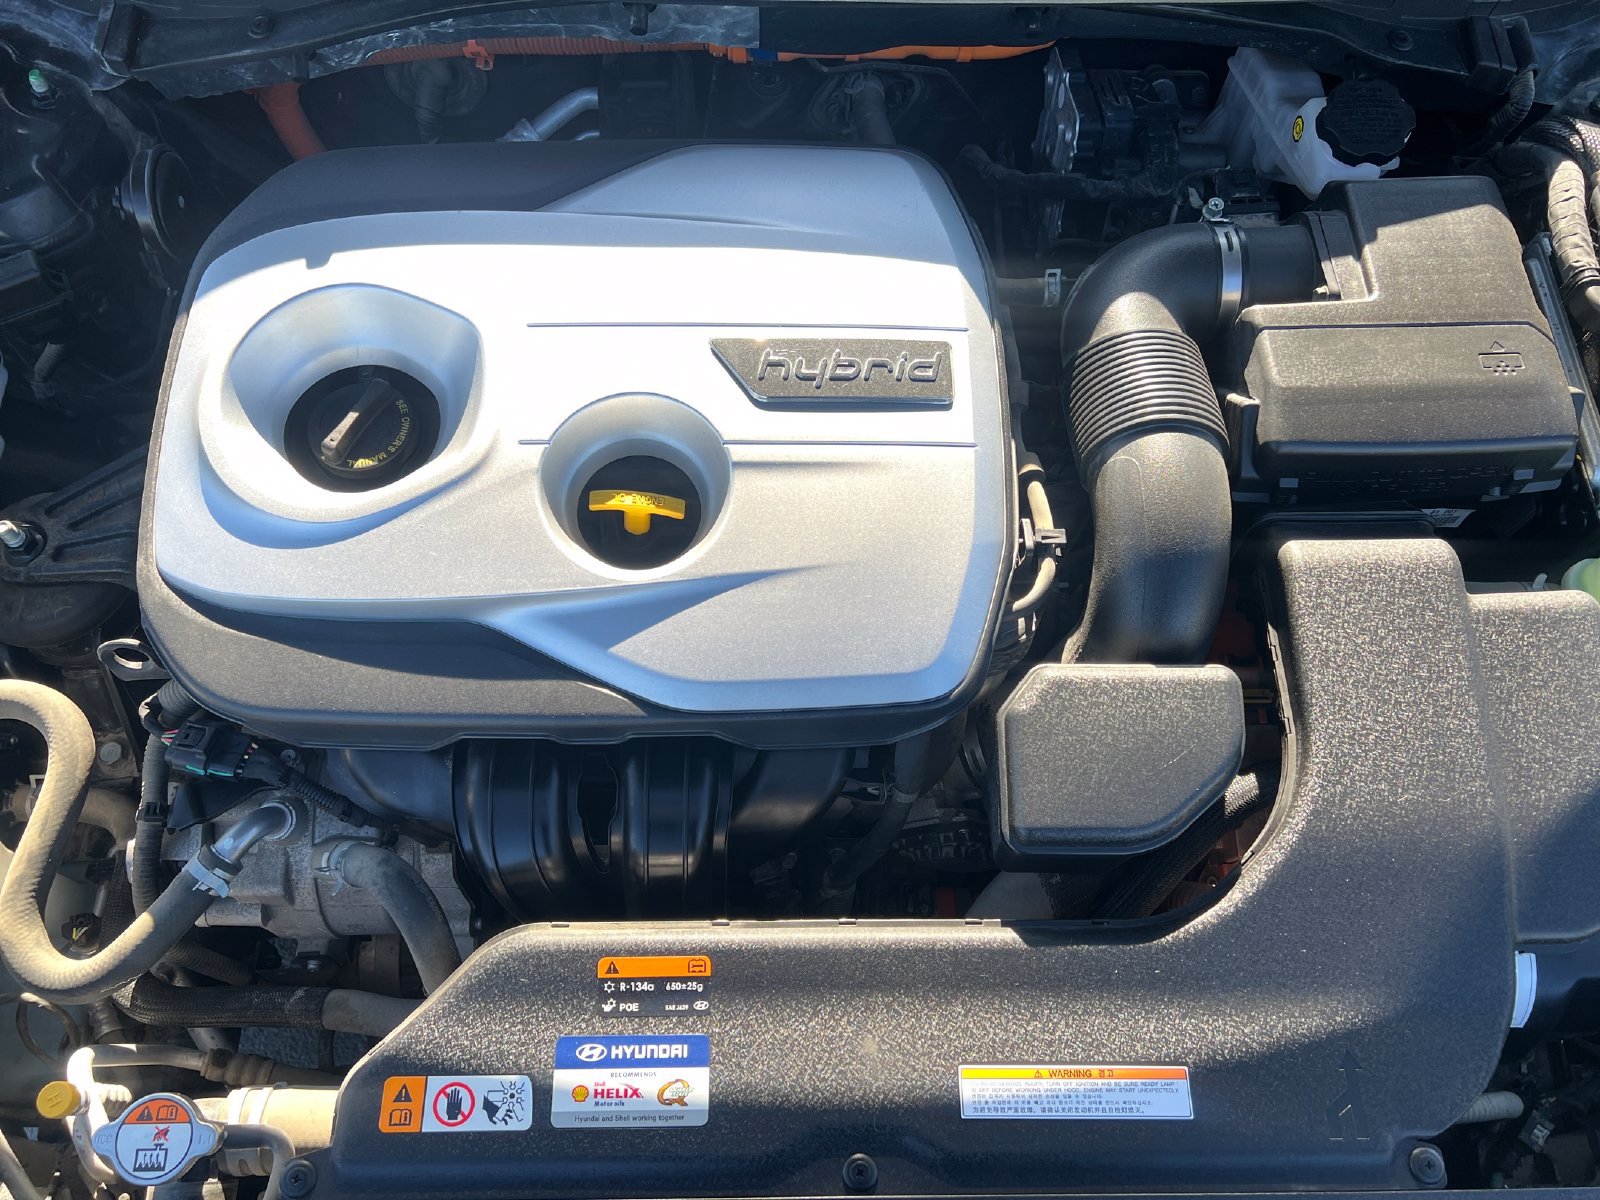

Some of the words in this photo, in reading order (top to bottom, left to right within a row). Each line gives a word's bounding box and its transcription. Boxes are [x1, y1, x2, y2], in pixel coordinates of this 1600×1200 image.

[758, 349, 942, 390] hybrid
[396, 399, 408, 414] SEE
[388, 416, 410, 453] OWNER'S
[346, 451, 388, 468] MANUAL
[620, 982, 654, 992] R-134a
[666, 982, 704, 992] 650±25g
[620, 1003, 639, 1012] POE
[610, 1044, 688, 1059] HYUNDAI
[1048, 1069, 1092, 1078] WARNING
[1098, 1069, 1114, 1078] 경고
[594, 1088, 641, 1098] HELIX
